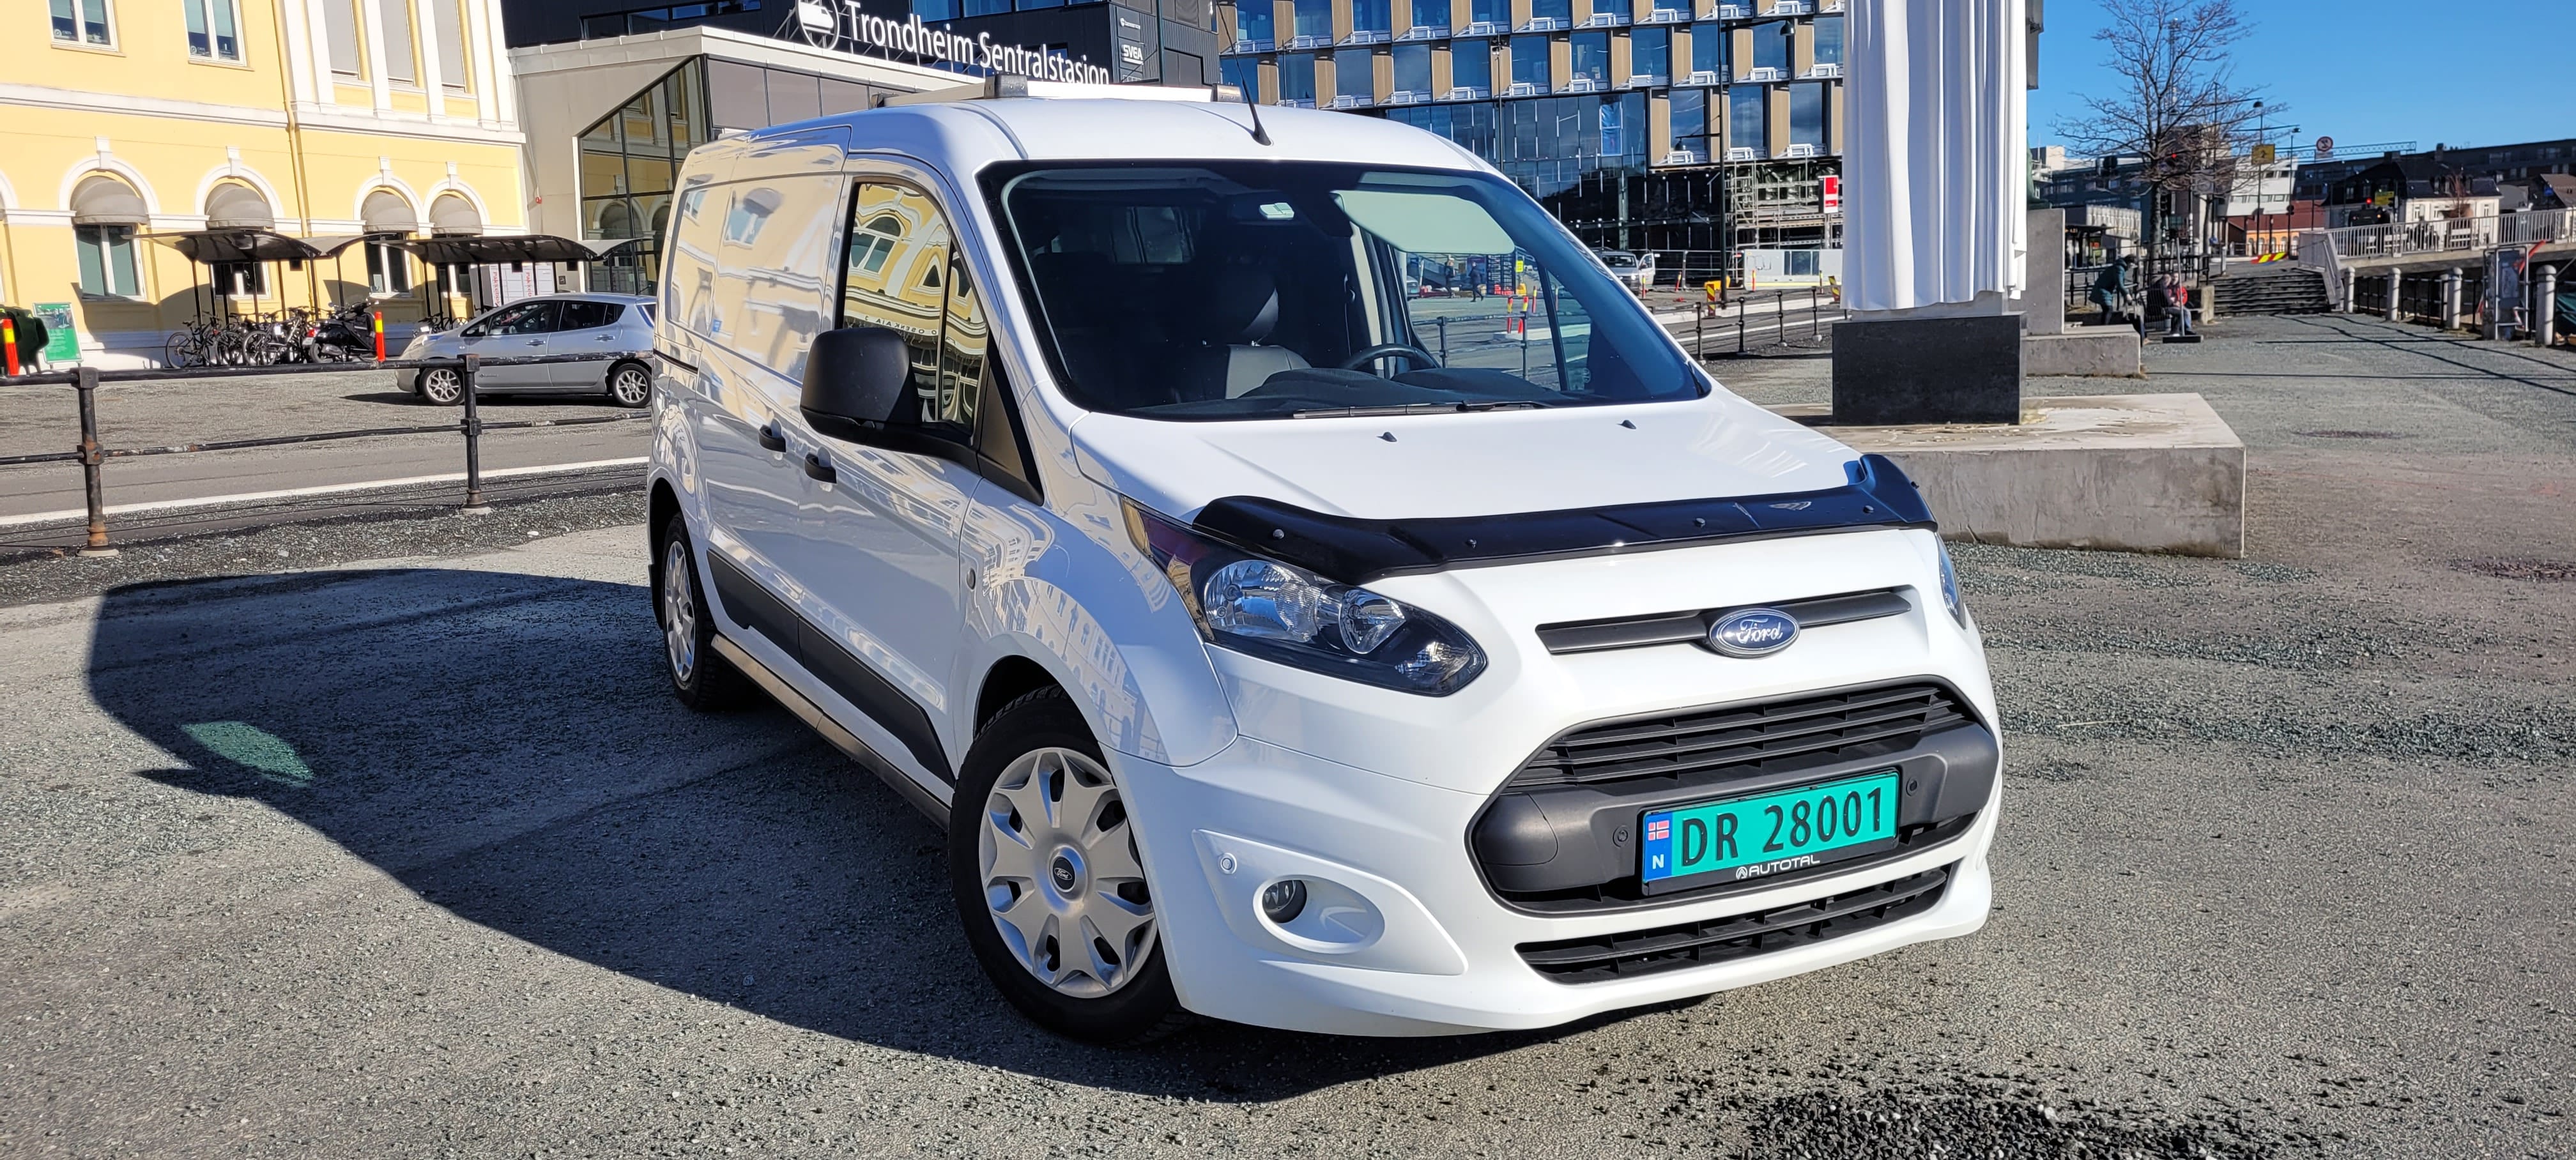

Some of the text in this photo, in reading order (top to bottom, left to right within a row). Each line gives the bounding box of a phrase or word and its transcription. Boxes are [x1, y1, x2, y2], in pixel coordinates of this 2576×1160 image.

[845, 0, 1109, 84] Trondheim Sentralstasion
[1123, 45, 1143, 61] SVEA
[1736, 618, 1784, 645] Ford
[1682, 786, 1882, 867] DR 28001
[1652, 854, 1664, 869] N
[1748, 854, 1820, 878] AUTOTAL
